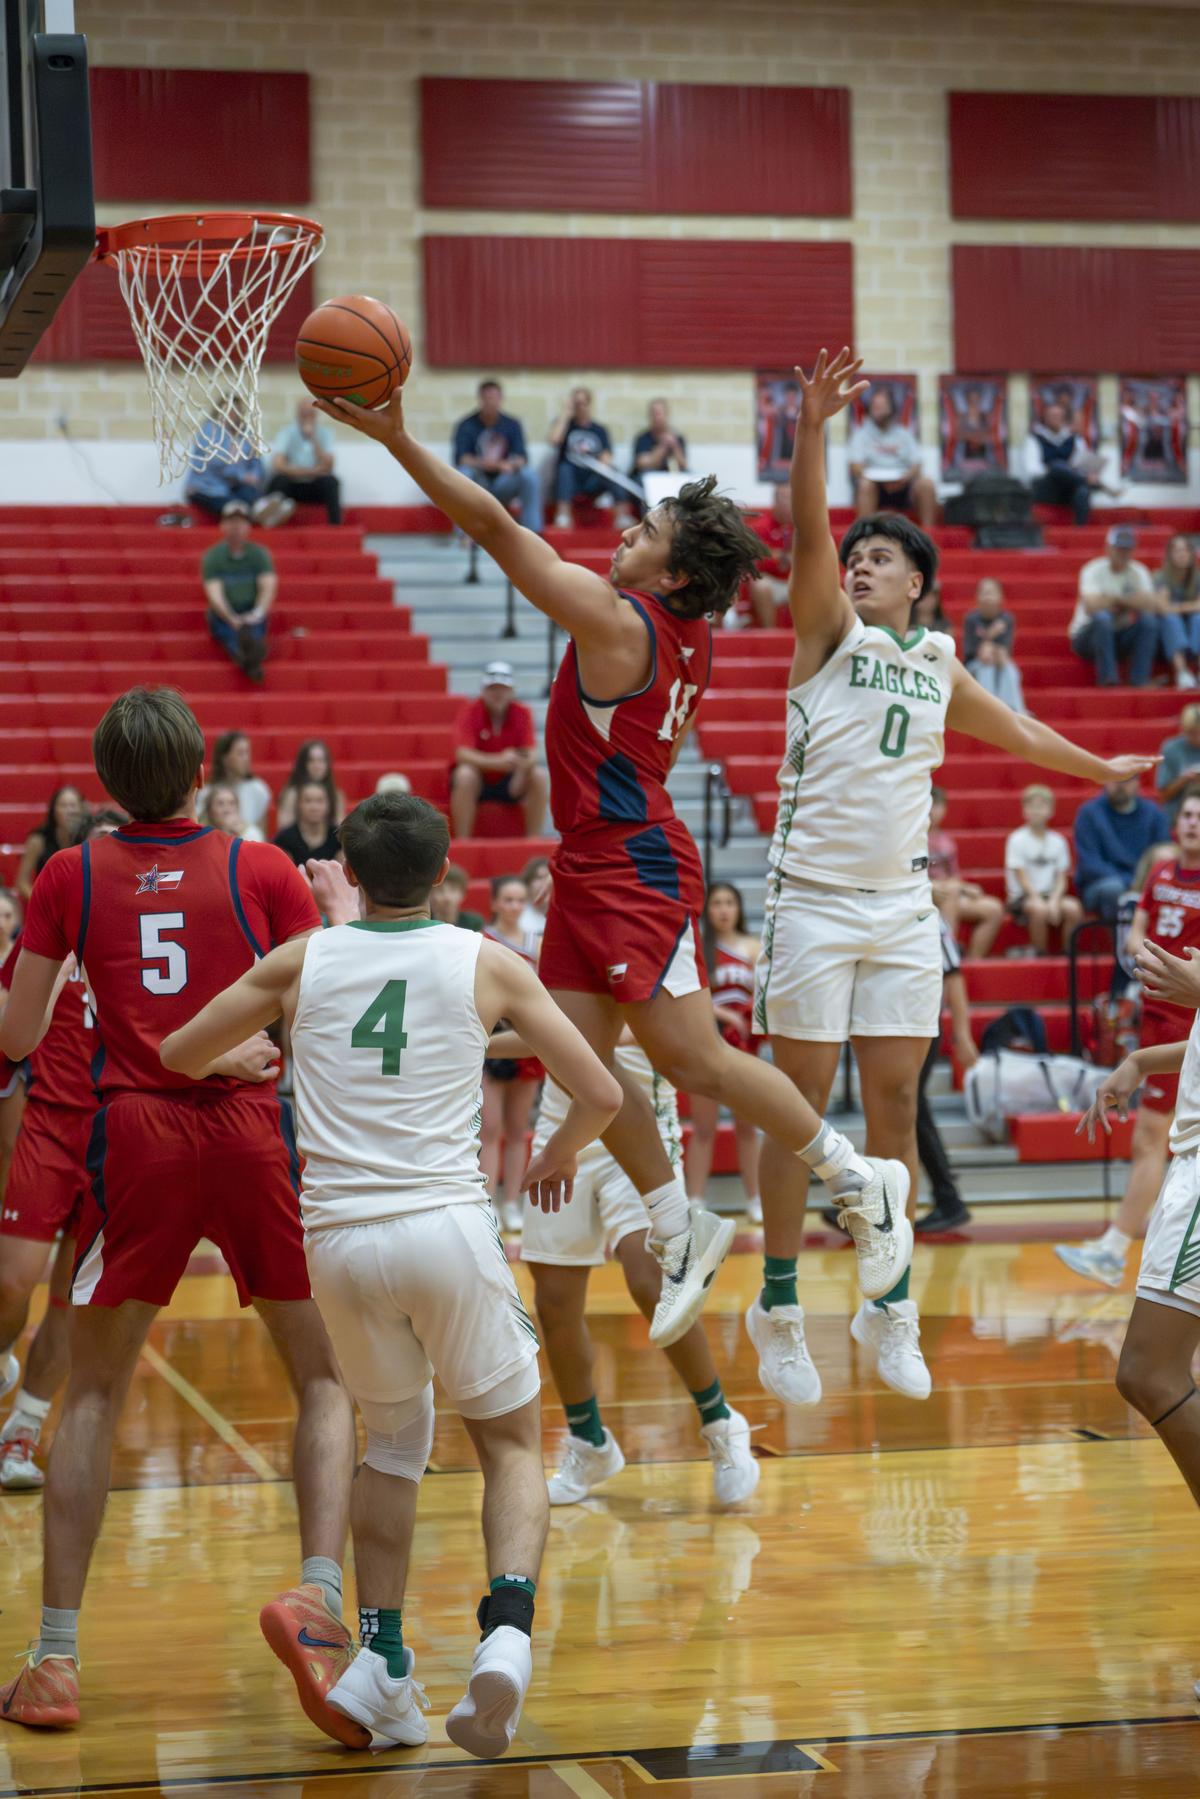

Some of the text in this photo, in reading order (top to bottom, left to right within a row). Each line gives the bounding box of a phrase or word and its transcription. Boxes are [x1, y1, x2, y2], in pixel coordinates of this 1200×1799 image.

[849, 655, 942, 705] EAGLES
[880, 703, 911, 758] 0
[139, 911, 188, 995] 5
[351, 979, 408, 1076] 4
